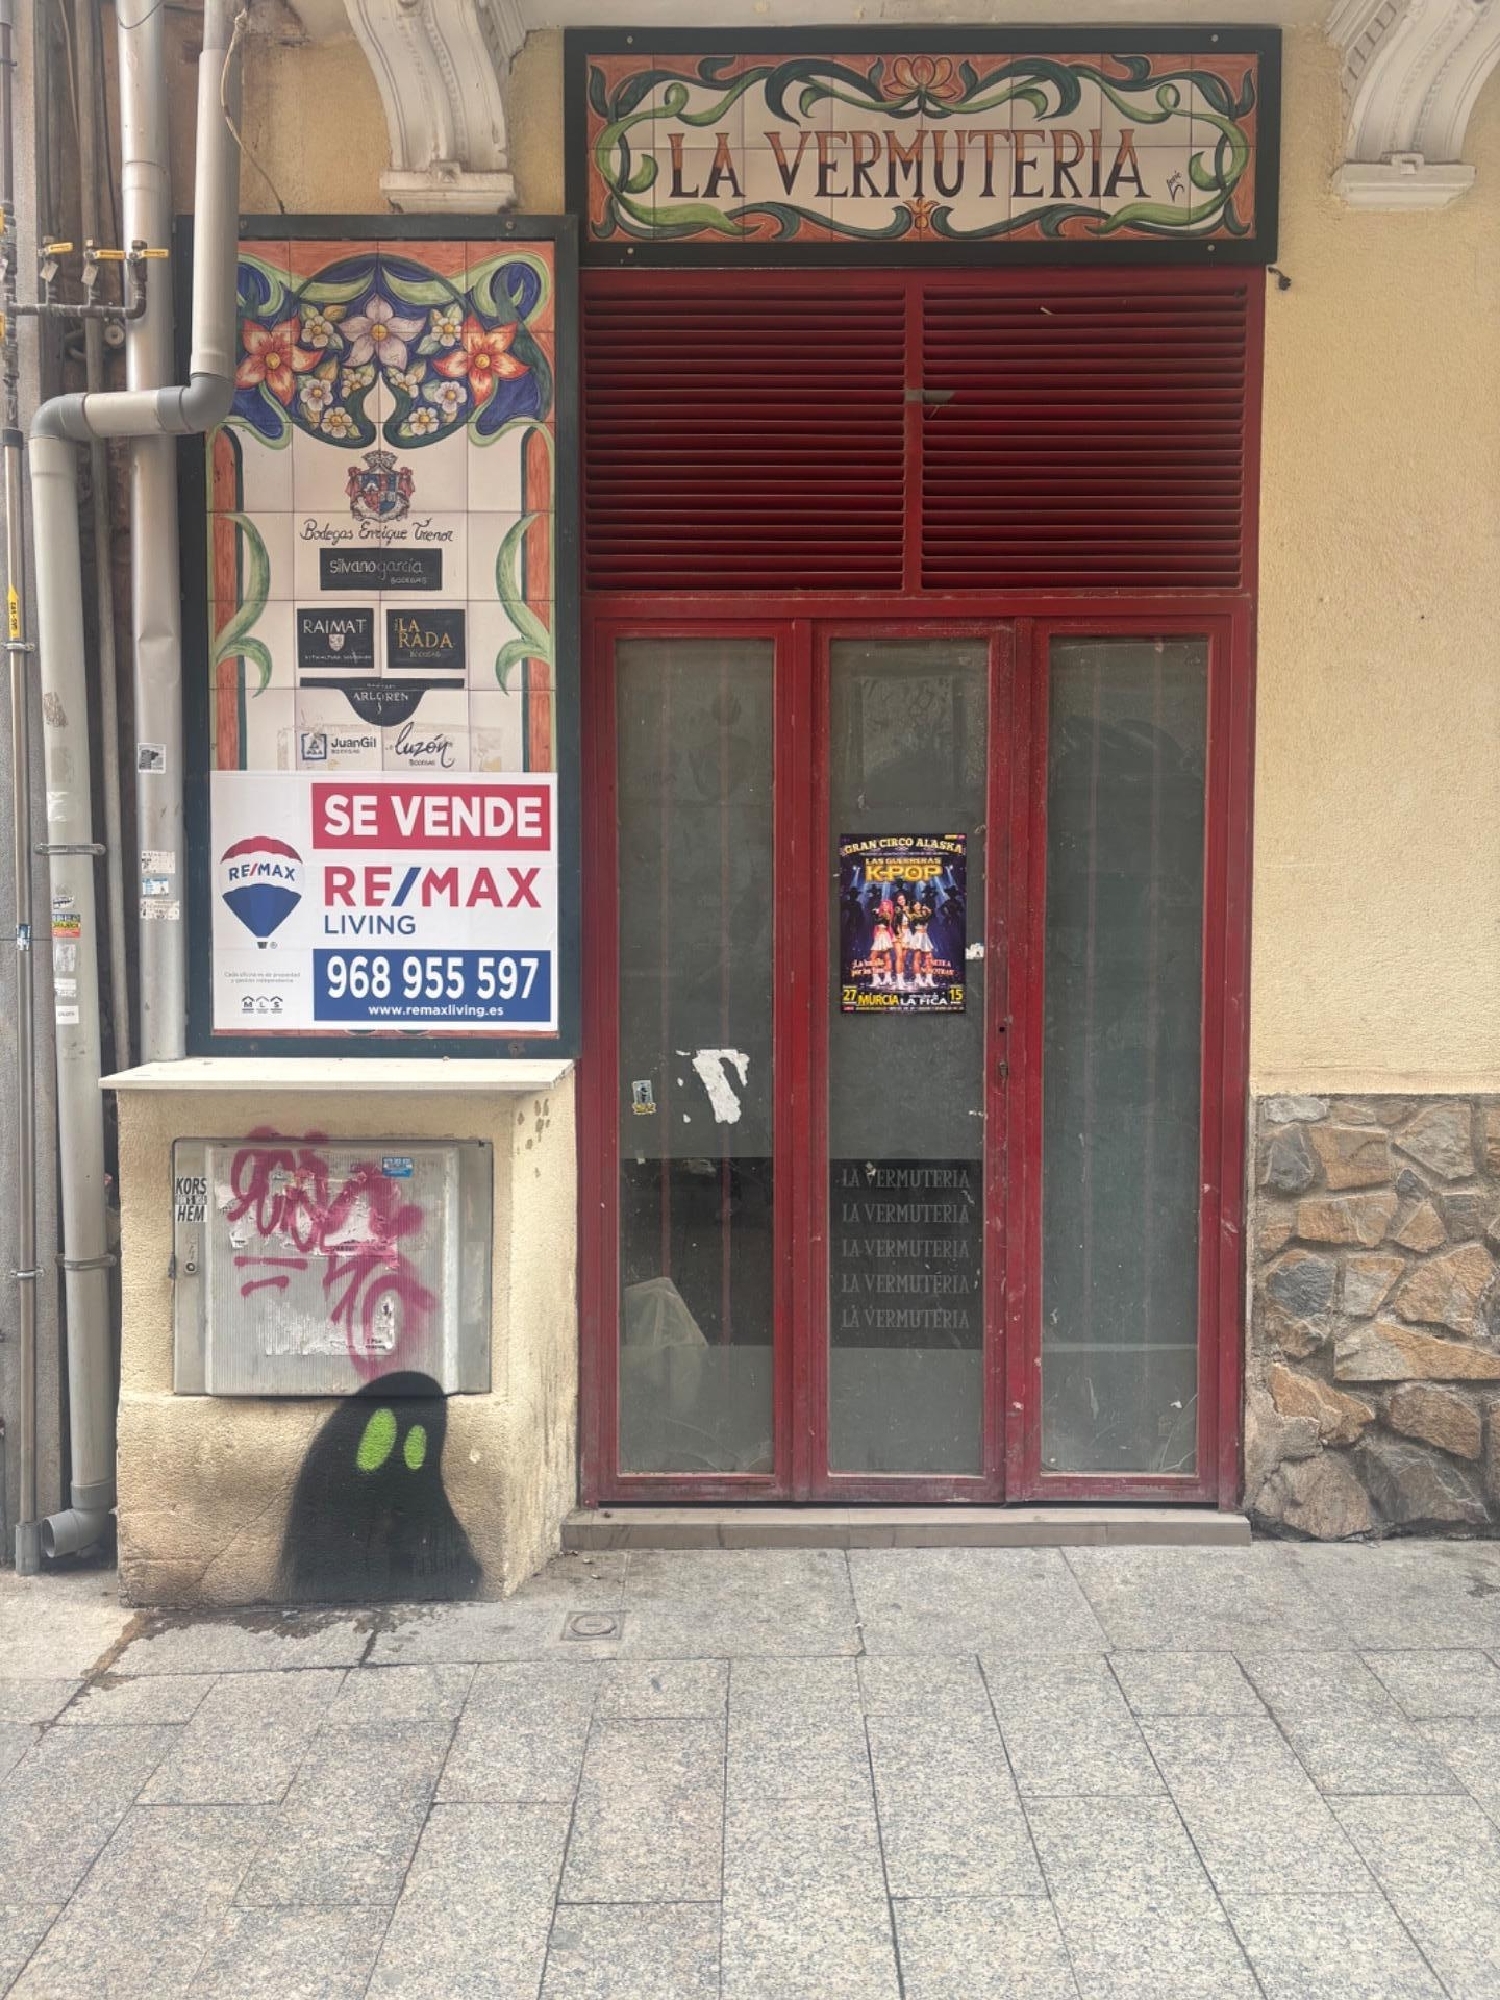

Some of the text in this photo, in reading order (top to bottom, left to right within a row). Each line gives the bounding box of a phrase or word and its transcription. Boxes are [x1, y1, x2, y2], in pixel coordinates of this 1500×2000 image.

[668, 132, 745, 199] LA
[765, 129, 1151, 199] VERMUTERIA
[300, 517, 454, 546] Bodegas Enrique Trenor
[303, 619, 367, 634] RAIMAT
[399, 618, 420, 633] LA
[399, 632, 454, 649] RADA
[331, 737, 377, 749] JuanGil
[394, 721, 455, 769] luzón
[324, 795, 542, 838] SE VENDE
[844, 838, 963, 855] GRAN CIRCO ALASKA
[228, 862, 296, 882] RE/MAX
[865, 865, 944, 883] K-POP
[324, 866, 542, 908] RE/MAX
[324, 914, 417, 935] LIVING
[326, 955, 540, 1000] 968 955 597
[843, 989, 858, 1001] 27
[900, 997, 917, 1006] LA
[920, 997, 948, 1006] FICA
[949, 988, 964, 1001] 15
[368, 1003, 504, 1018] www.remaxliving.es
[175, 1177, 208, 1195] KORS
[842, 1168, 970, 1187] LA VERMUTERIA
[177, 1205, 205, 1222] HEM
[842, 1203, 970, 1223] LA VERMUTERIA
[842, 1239, 970, 1258] LA VERMUTERIA
[842, 1274, 970, 1294] LA VERMUTERIA
[842, 1309, 970, 1329] LA VERMUTERIA
